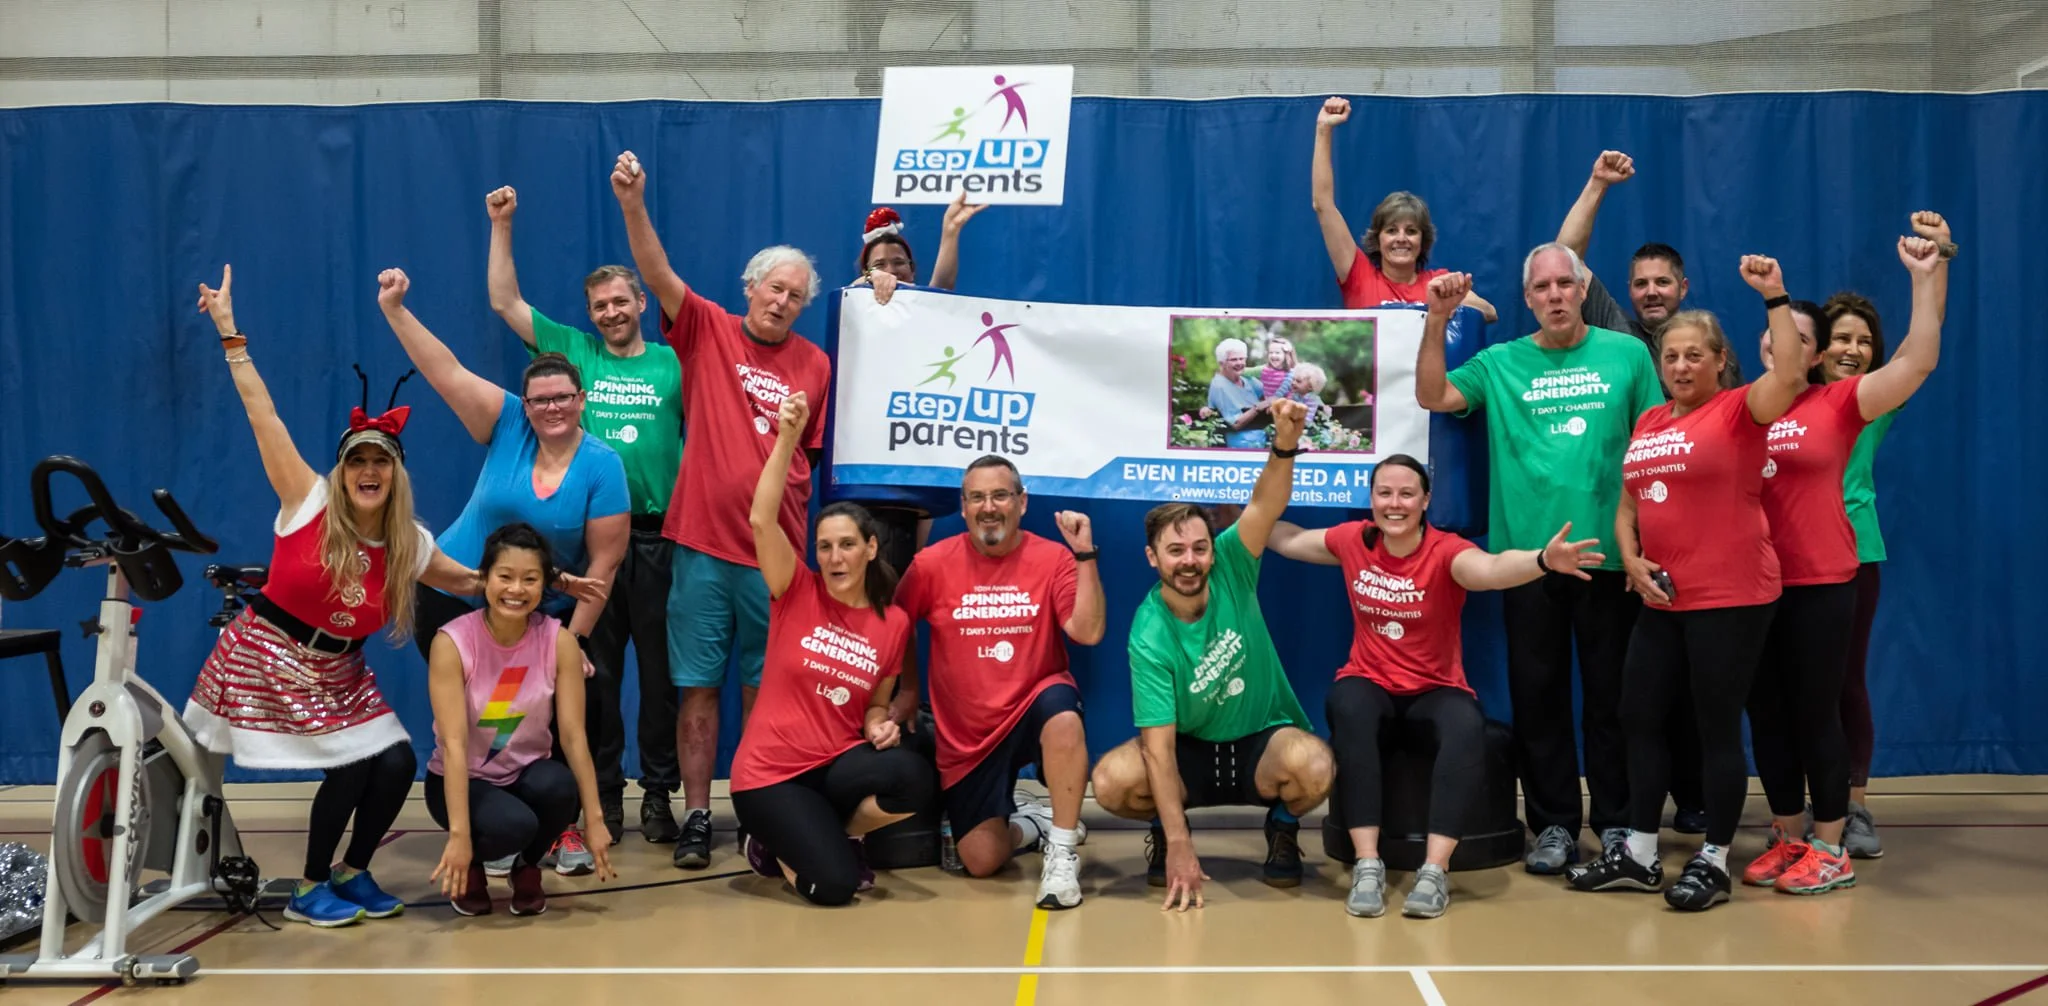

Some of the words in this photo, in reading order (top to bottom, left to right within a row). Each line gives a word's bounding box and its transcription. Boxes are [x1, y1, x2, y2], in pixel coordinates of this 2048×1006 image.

[898, 149, 967, 170] step
[983, 140, 1043, 169] up
[895, 169, 1043, 198] parents
[593, 379, 655, 395] SPINNING
[1531, 371, 1601, 389] SPINNING
[586, 390, 663, 407] GENEROSITY
[1522, 383, 1611, 402] GENEROSITY
[596, 410, 613, 419] DAYS
[614, 411, 619, 419] 7
[620, 411, 655, 421] CHARITIES
[891, 391, 957, 421] step
[973, 390, 1029, 427] up
[1531, 408, 1536, 416] 7
[1537, 406, 1557, 416] DAYS
[1559, 405, 1563, 413] 7
[1565, 402, 1606, 413] CHARITIES
[888, 421, 1030, 456] parents
[1767, 442, 1800, 452] ARITIES
[1123, 463, 1176, 481] EVEN
[1183, 466, 1263, 485] HEROES
[1334, 469, 1347, 487] A
[1646, 463, 1687, 476] CHARITIES
[1639, 484, 1667, 501] LizFit
[1359, 569, 1416, 592] SPINNING
[961, 592, 1031, 606] SPINNING
[1353, 579, 1426, 603] GENEROSITY
[952, 604, 1040, 620] GENEROSITY
[1376, 607, 1381, 615] 7
[1381, 608, 1422, 619] CHARITIES
[960, 627, 965, 636] 7
[966, 627, 985, 636] DAYS
[987, 627, 992, 635] 7
[993, 625, 1033, 635] CHARITIES
[813, 626, 878, 661] SPINNING
[977, 644, 1013, 660] LizFit
[800, 636, 880, 676] GENEROSITY
[803, 658, 809, 667] 7
[809, 660, 830, 674] DAYS
[831, 668, 837, 676] 7
[836, 671, 872, 692] CHARITIES
